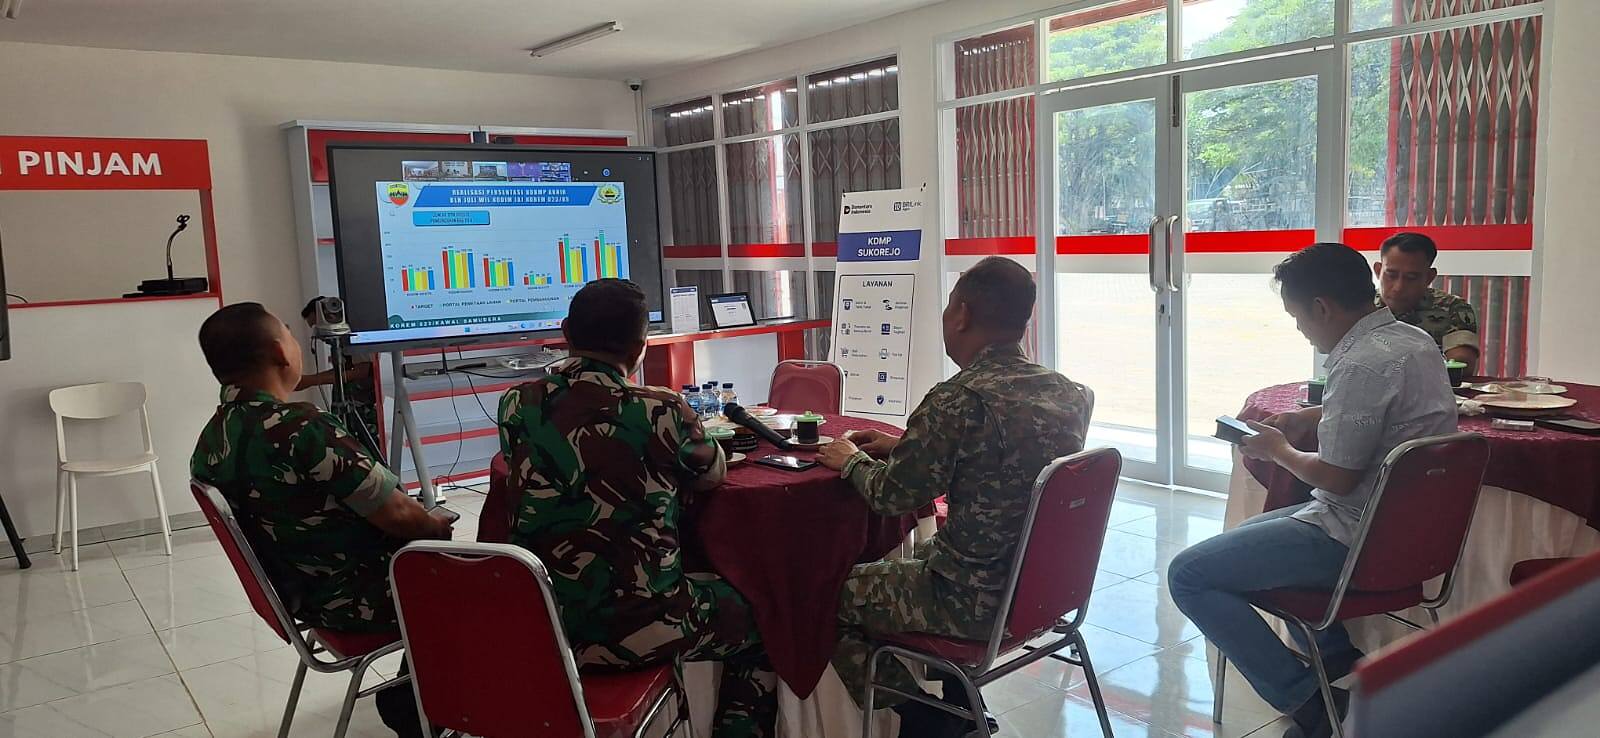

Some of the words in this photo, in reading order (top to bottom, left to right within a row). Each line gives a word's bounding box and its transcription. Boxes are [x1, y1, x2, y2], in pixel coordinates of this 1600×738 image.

[18, 150, 162, 176] PINJAM
[867, 236, 892, 246] KDMP
[857, 247, 901, 257] SUKOREJO
[862, 280, 893, 288] LAYANAN
